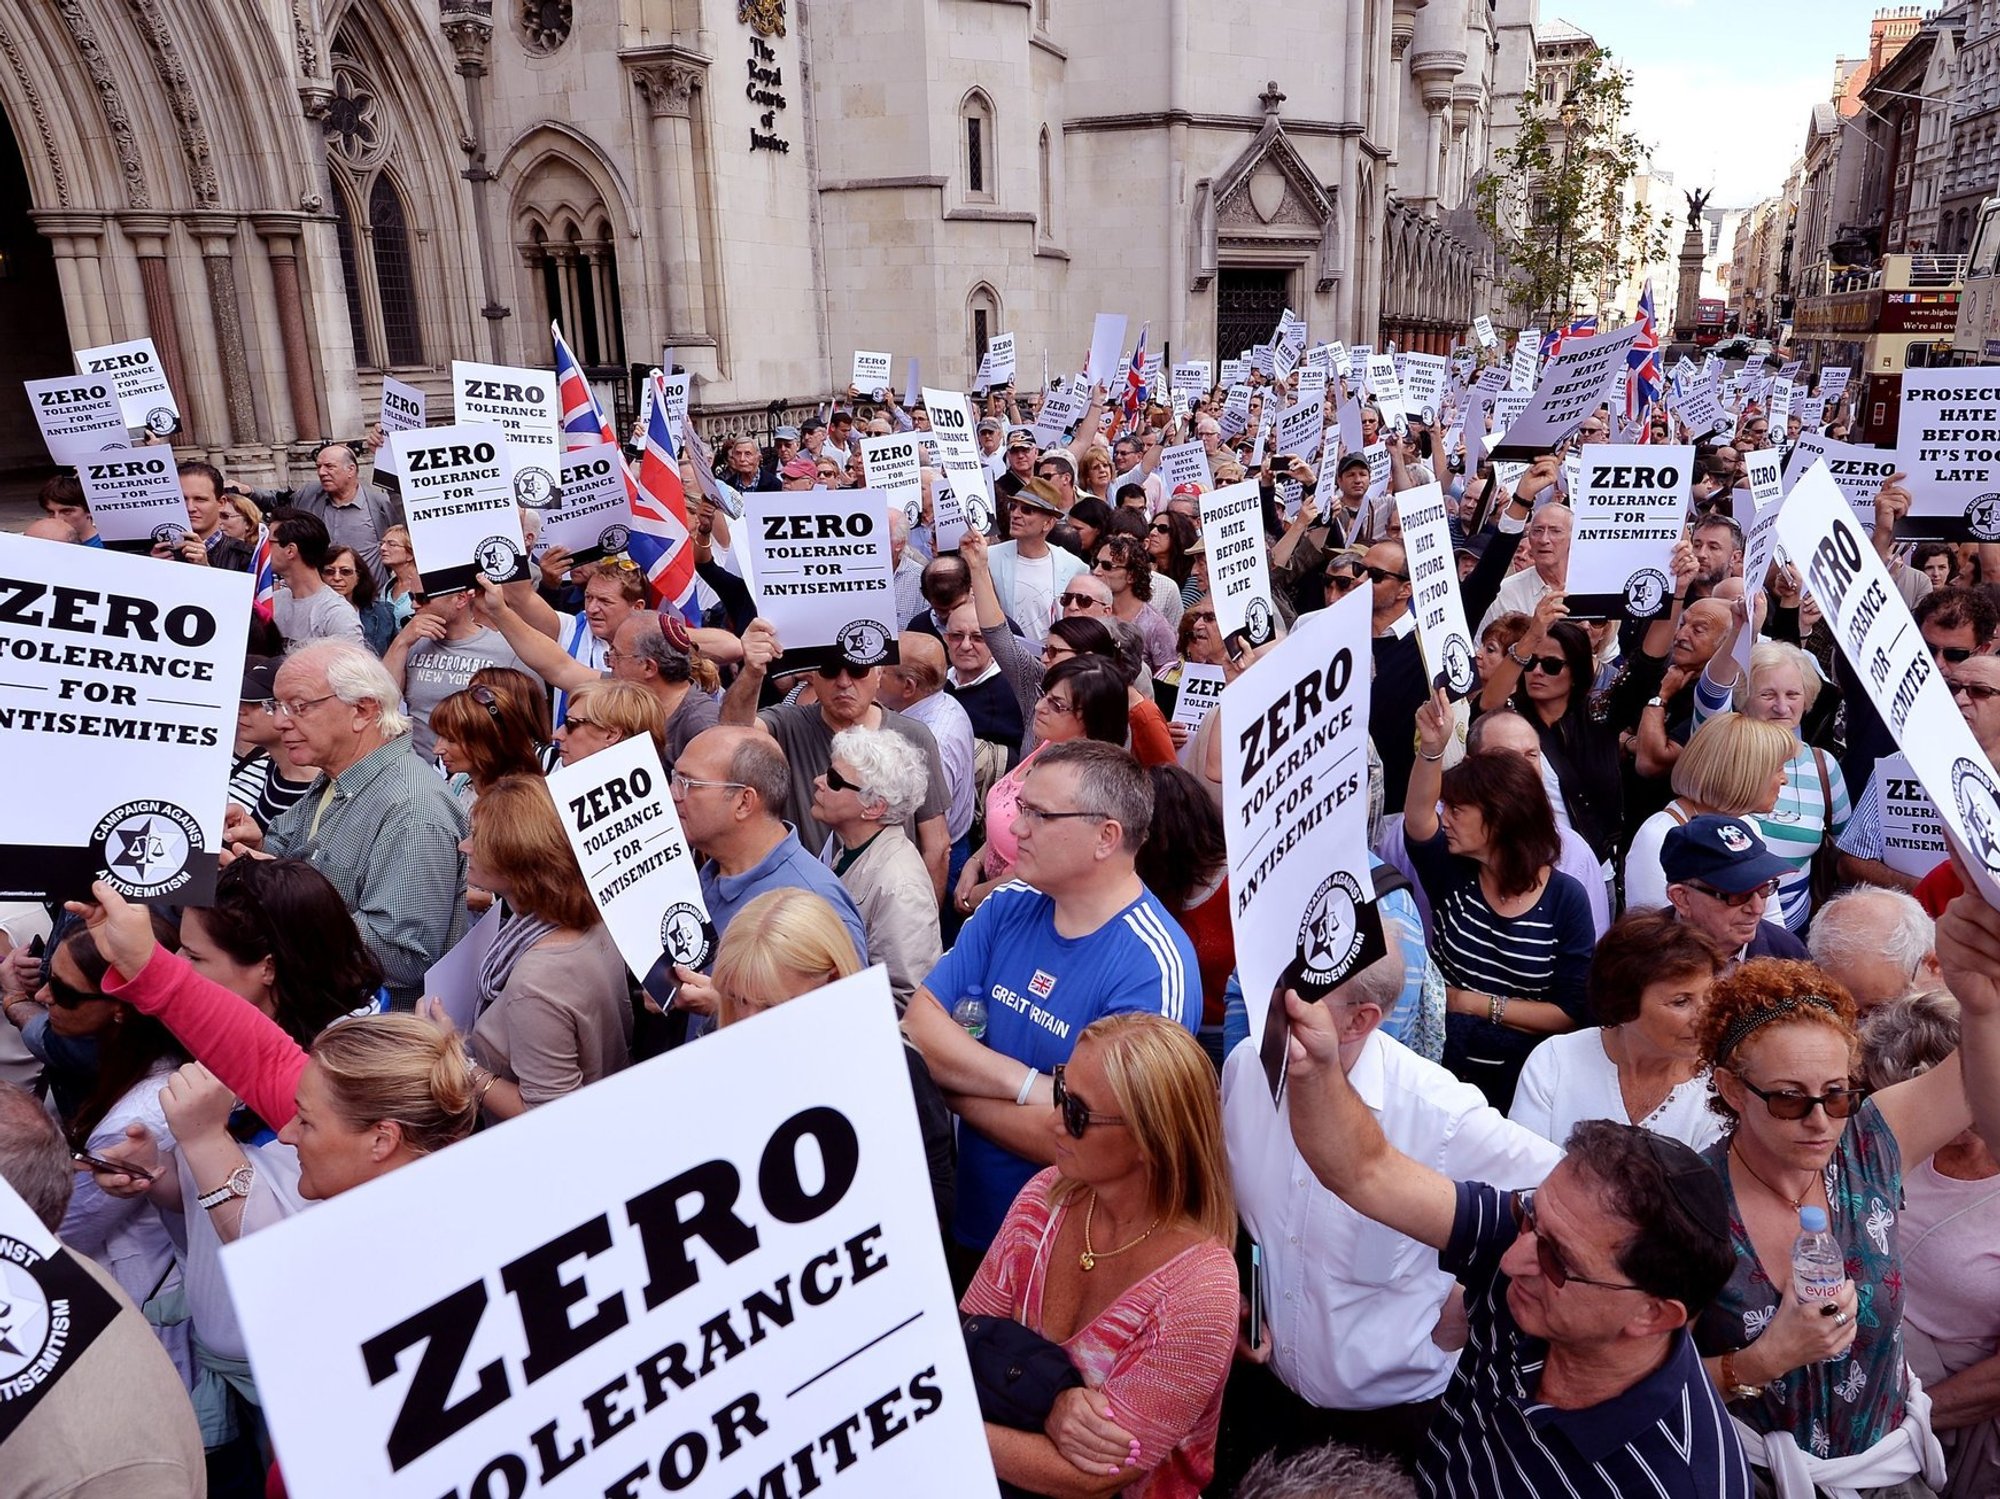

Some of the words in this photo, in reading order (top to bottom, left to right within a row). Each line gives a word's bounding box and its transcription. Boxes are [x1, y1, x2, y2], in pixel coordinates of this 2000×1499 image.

[750, 36, 775, 62] The
[747, 59, 782, 87] Royal
[746, 82, 786, 109] Courts
[761, 110, 775, 129] of
[750, 128, 789, 155] Justice
[1903, 322, 1928, 330] We're
[1930, 322, 1942, 330] all
[992, 339, 1013, 351] ZERO
[1280, 344, 1296, 361] ZERO
[1309, 351, 1326, 359] ZERO
[1555, 335, 1638, 366] PROSECUTE
[89, 351, 150, 374] ZERO
[858, 357, 887, 365] ZERO
[1373, 365, 1392, 377] ZERO
[1407, 360, 1444, 369] PROSECUTE
[1571, 359, 1610, 378] HATE
[117, 379, 139, 388] FOR
[1410, 377, 1436, 385] BEFORE
[1484, 371, 1506, 381] ZERO
[1552, 373, 1610, 395] BEFORE
[38, 385, 107, 406] ZERO
[464, 379, 545, 403] ZERO
[1542, 397, 1573, 411] IT'S
[1575, 388, 1600, 407] TOO
[1676, 389, 1711, 409] PROSECUTE
[43, 401, 112, 416] TOLERANCE
[385, 391, 420, 417] ZERO
[465, 402, 547, 418] TOLERANCE
[1047, 400, 1070, 412] ZERO
[1687, 402, 1712, 417] BEFORE
[1688, 400, 1705, 410] HATE
[1702, 407, 1716, 418] TOO
[69, 413, 93, 423] FOR
[384, 408, 422, 429] TOLERANCE
[930, 407, 964, 428] ZERO
[1044, 410, 1068, 419] TOLERANCE
[1228, 412, 1245, 423] ZERO
[1282, 402, 1319, 429] ZERO
[1546, 408, 1584, 424] LATE
[1698, 416, 1713, 424] LATE
[1939, 409, 1996, 421] HATE
[46, 419, 121, 436] ANTISEMITES
[1282, 414, 1320, 436] TOLERANCE
[1295, 427, 1309, 438] FOR
[1280, 428, 1321, 451] ANTISEMITES
[407, 442, 495, 472] ZERO
[869, 444, 913, 463] ZERO
[1162, 447, 1203, 461] PROSECUTE
[1175, 458, 1193, 466] HATE
[1367, 449, 1389, 463] ZERO
[1919, 450, 1960, 462] IT'S
[88, 459, 165, 480] ZERO
[561, 459, 611, 484] ERO
[871, 460, 915, 472] TOLERANCE
[1171, 464, 1201, 476] BEFORE
[1751, 465, 1776, 486] ZERO
[1830, 460, 1896, 476] ZERO
[1935, 470, 1989, 481] LATE
[92, 476, 170, 491] TOLERANCE
[411, 468, 500, 488] TOLERANCE
[1172, 473, 1187, 482] IT'S
[1187, 472, 1202, 481] TOO
[1590, 466, 1678, 489] ZERO
[94, 496, 180, 511] ANTISEMITES
[120, 490, 149, 499] FOR
[443, 487, 474, 500] FOR
[570, 493, 596, 506] FOR
[1588, 495, 1677, 506] TOLERANCE
[1966, 493, 1997, 514] CAMPAIGN
[412, 498, 511, 521] ANTISEMITES
[547, 496, 625, 525] ANTISEMITES
[1203, 496, 1260, 525] PROSECUTE
[1402, 503, 1445, 532] PROSECUTE
[1613, 512, 1645, 523] FOR
[762, 513, 873, 540] ZERO
[1220, 523, 1246, 539] HATE
[1578, 529, 1677, 540] ANTISEMITES
[765, 544, 877, 559] TOLERANCE
[1216, 538, 1255, 561] BEFORE
[1416, 533, 1436, 554] HATE
[803, 564, 843, 575] FOR
[1218, 563, 1237, 581] IT'S
[1237, 556, 1257, 576] TOO
[1414, 556, 1445, 582] BEFORE
[762, 579, 887, 596] ANTISEMITES
[1226, 577, 1251, 597] LATE
[1418, 586, 1433, 607] IT'S
[1432, 579, 1448, 601] TOO
[0, 577, 217, 648] ZERO
[1426, 607, 1446, 631] LATE
[838, 620, 866, 642] CAMPAIGN
[867, 620, 891, 640] AGAINST
[408, 654, 494, 672] ABERCROMBIE
[842, 650, 888, 664] ANTISEMITISM
[417, 671, 443, 682] NEW
[448, 672, 470, 686] YOR
[58, 679, 137, 706] FOR
[0, 708, 218, 746] NTISEMITES
[1239, 646, 1353, 788] ZERO
[1241, 704, 1353, 829] TOLERANCE
[568, 767, 652, 833] ZERO
[1275, 775, 1314, 832] FOR
[94, 802, 160, 840] CAMPAIGN
[161, 805, 202, 849] AGAINST
[583, 802, 663, 856] TOLERANCE
[1912, 824, 1942, 835] FOR
[613, 839, 643, 865] FOR
[1237, 772, 1359, 920] ANTISEMITES
[1885, 837, 1949, 852] ANTISEM
[599, 843, 683, 907] ANTISEMITES
[1297, 878, 1331, 946] CAMPAIGN
[1332, 873, 1363, 904] AGAINST
[662, 905, 678, 946] CAMPAIGN
[679, 903, 705, 923] AGAINST
[1301, 932, 1365, 985] ANTISEMITISM
[991, 984, 1030, 1014] GREAT
[360, 1104, 861, 1474] ZERO
[1805, 1283, 1843, 1297] evian
[0, 1299, 70, 1402] TISEMITISM
[435, 1222, 891, 1499] OLERANCE
